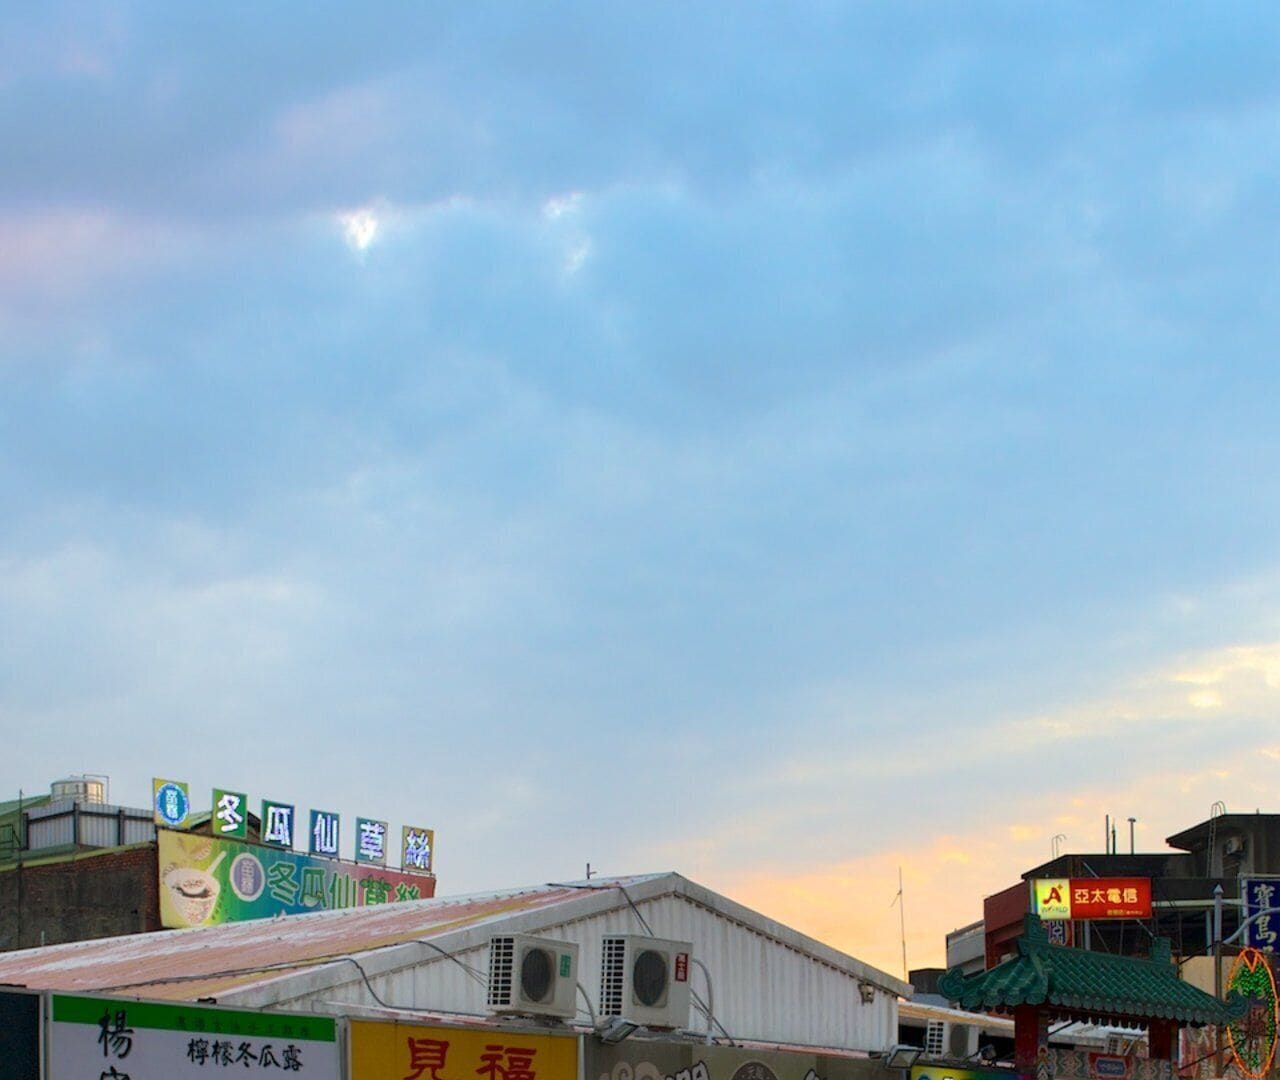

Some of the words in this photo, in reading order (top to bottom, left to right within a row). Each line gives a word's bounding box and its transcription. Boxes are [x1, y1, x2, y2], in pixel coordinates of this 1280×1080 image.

[1074, 887, 1138, 905] 亞太電信
[1253, 882, 1277, 954] 寶島
[186, 1037, 304, 1072] 檸檬冬瓜露
